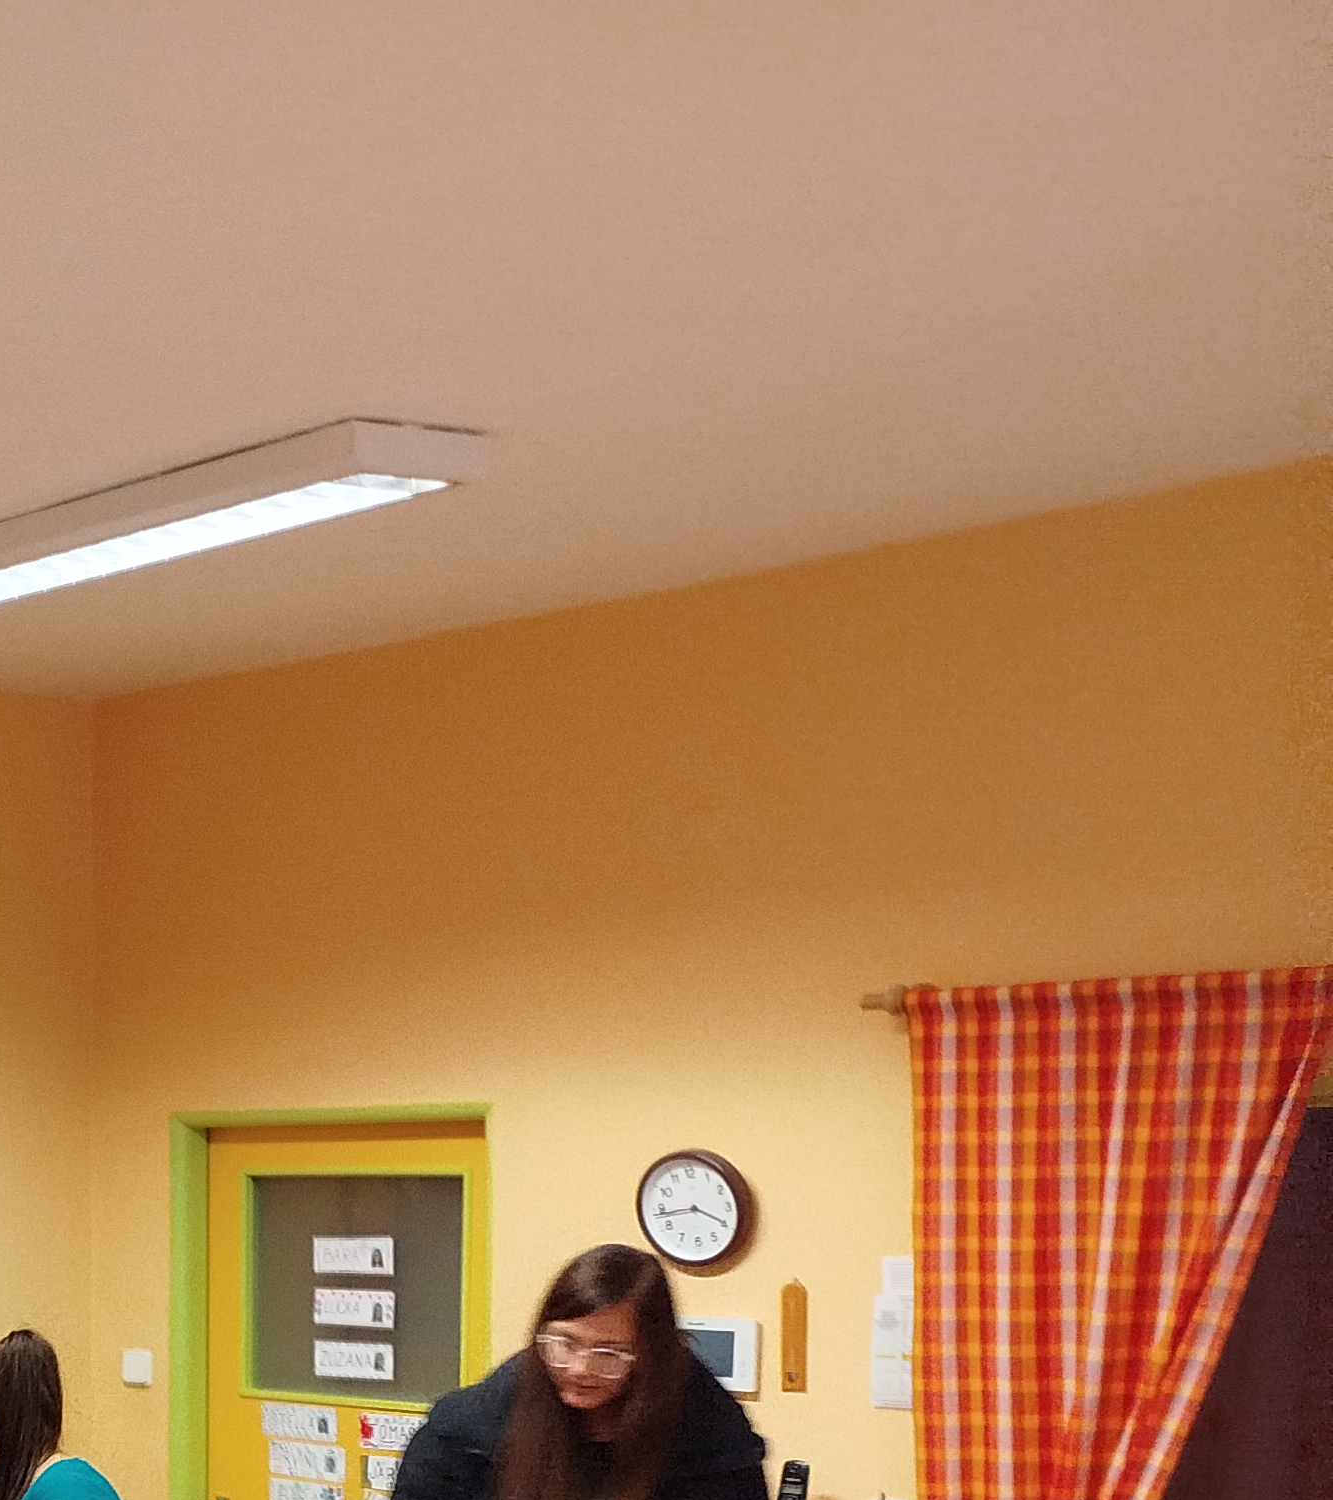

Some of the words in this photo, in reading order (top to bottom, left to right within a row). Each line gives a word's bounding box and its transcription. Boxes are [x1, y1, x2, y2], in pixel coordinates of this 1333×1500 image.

[684, 1166, 696, 1179] 12
[660, 1187, 673, 1198] 10
[717, 1184, 724, 1196] 2
[725, 1201, 732, 1212] 3
[665, 1220, 674, 1231] 8
[678, 1232, 686, 1242] 7
[694, 1236, 703, 1247] 6
[710, 1231, 718, 1243] 5
